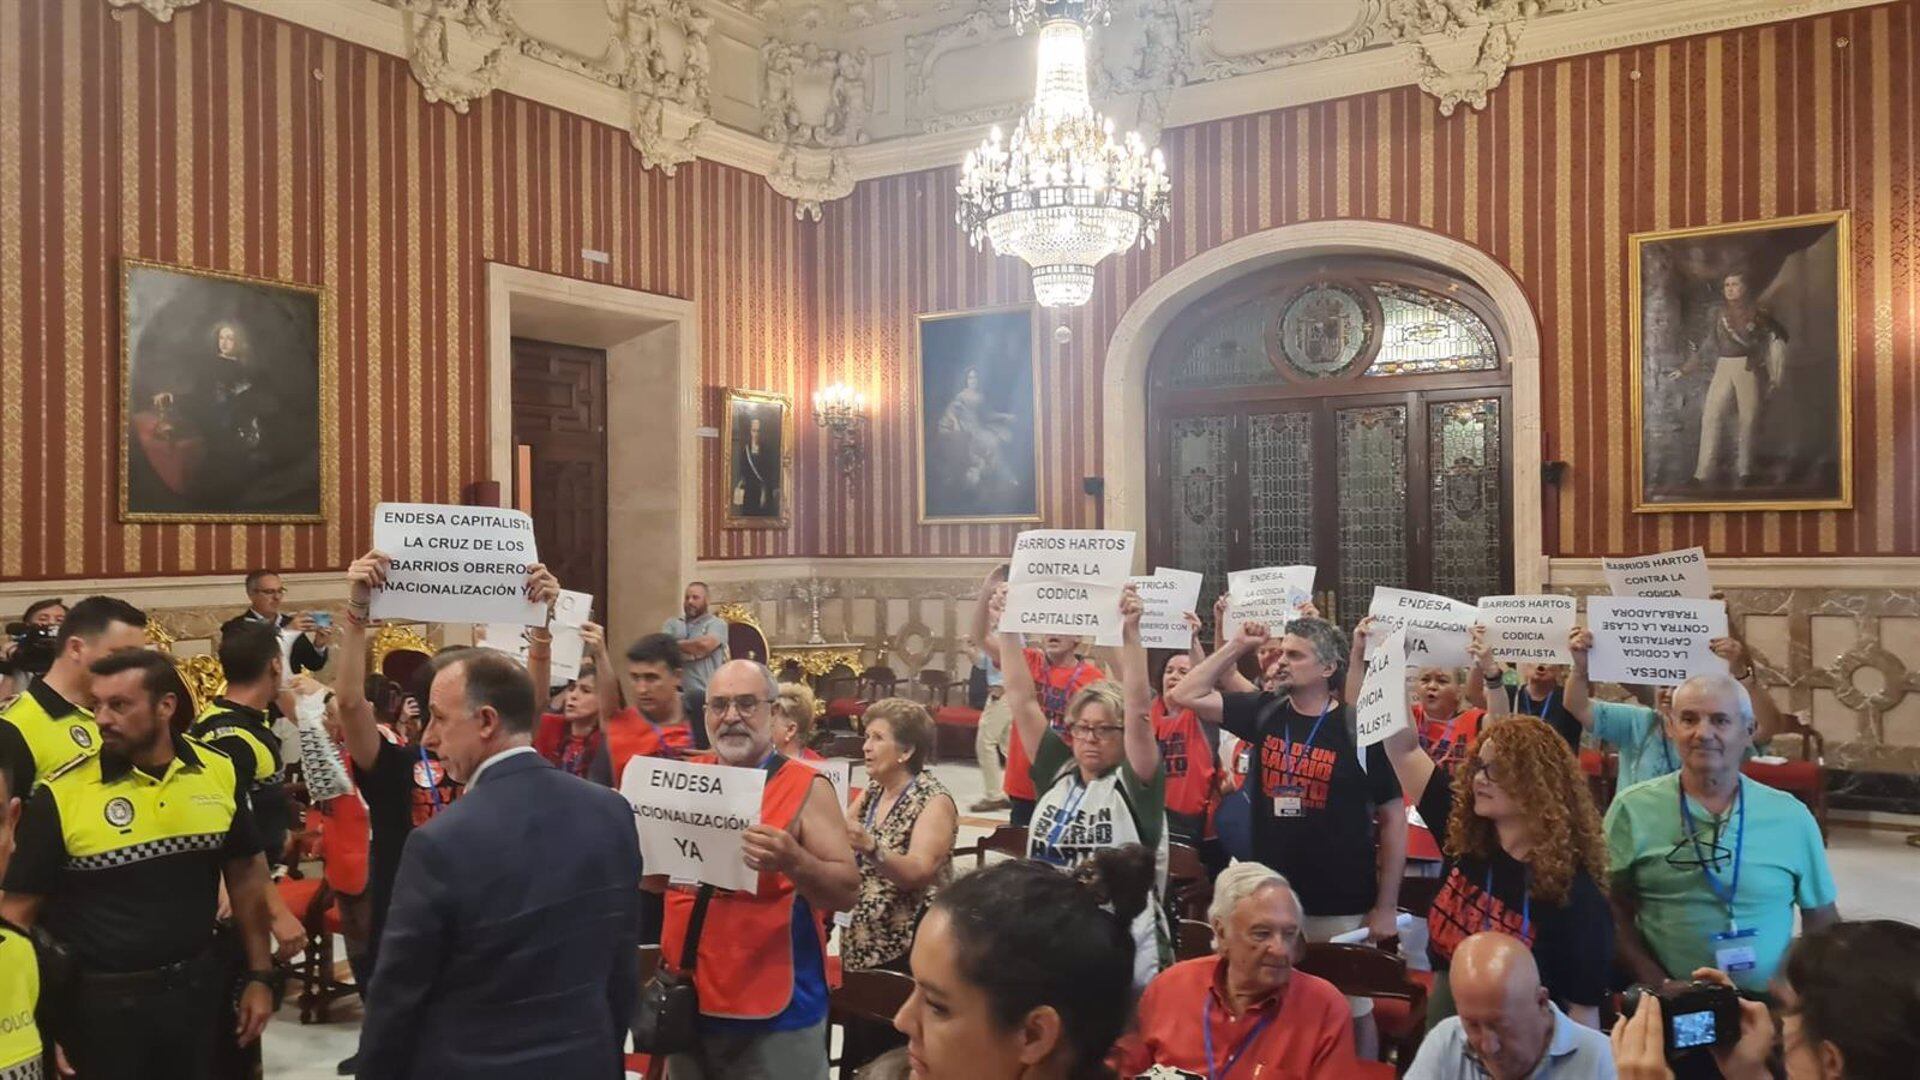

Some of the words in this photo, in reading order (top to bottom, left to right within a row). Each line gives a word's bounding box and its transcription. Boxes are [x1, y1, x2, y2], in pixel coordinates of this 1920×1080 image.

[384, 511, 446, 525] ENDESA
[404, 537, 423, 548] LA
[428, 537, 469, 550] CRUZ
[473, 539, 493, 551] DE
[497, 540, 524, 552] LOS
[1018, 538, 1066, 550] BARRIOS
[1069, 538, 1126, 551] HARTOS
[390, 559, 459, 573] BARRIOS
[1606, 560, 1650, 571] BARRIOS
[1652, 553, 1699, 568] HARTOS
[1027, 562, 1080, 575] CONTRA
[1084, 563, 1100, 576] LA
[1624, 574, 1668, 585] CONTRA
[1670, 573, 1686, 582] LA
[1036, 588, 1088, 601] CODICIA
[1638, 590, 1682, 598] CODICIA
[1398, 597, 1452, 612] ENDESA
[1482, 600, 1526, 608] BARRIOS
[1528, 600, 1571, 609] HARTOS
[1020, 612, 1100, 626] CAPITALISTA
[1612, 608, 1699, 620] TRABAJADORA
[1495, 616, 1537, 624] CONTRA
[1540, 616, 1553, 625] LA
[1602, 621, 1639, 631] CLASE
[1642, 623, 1658, 632] LA
[1660, 624, 1709, 634] CONTRA
[1502, 632, 1545, 641] CODICIA
[1619, 635, 1692, 647] CAPITALISTA
[1492, 648, 1556, 658] CAPITALISTA
[1623, 648, 1670, 659] CODICIA
[1673, 650, 1688, 659] LA
[1626, 667, 1687, 679] ENDESA:
[1359, 712, 1392, 736] ALISTA
[651, 769, 723, 795] ENDESA
[632, 804, 750, 831] ACIONALIZACIÓN
[674, 837, 703, 862] YA
